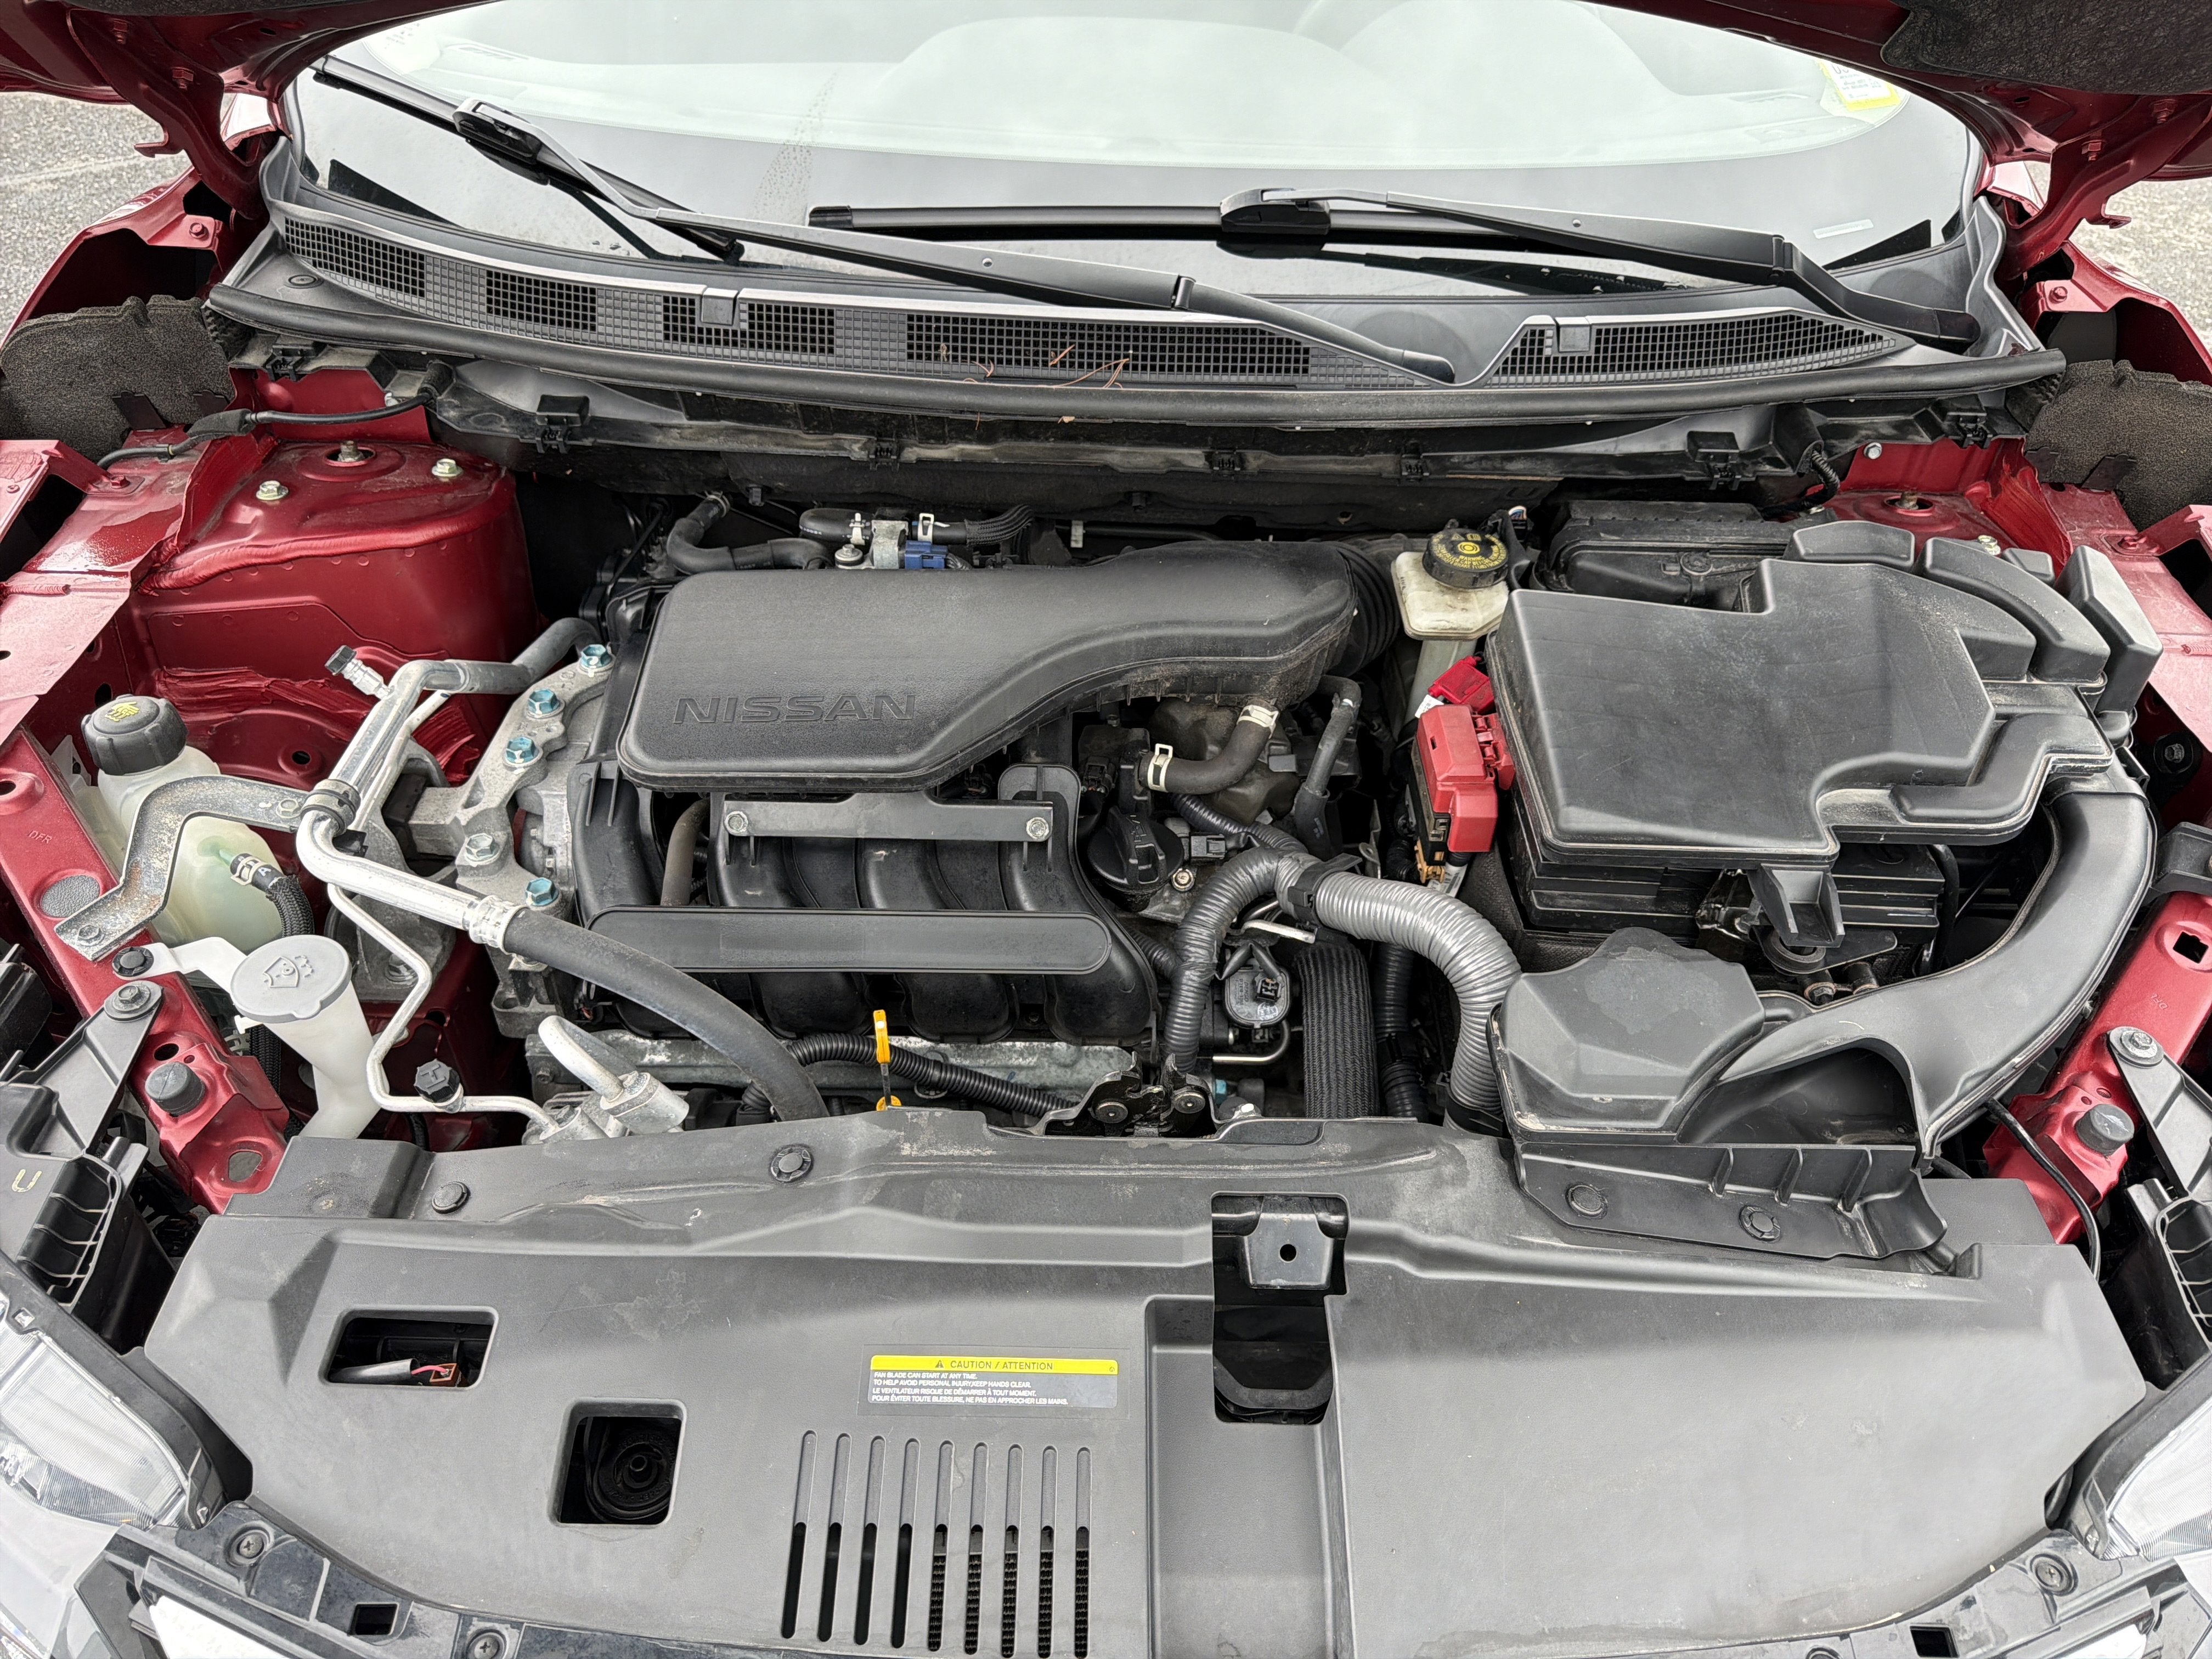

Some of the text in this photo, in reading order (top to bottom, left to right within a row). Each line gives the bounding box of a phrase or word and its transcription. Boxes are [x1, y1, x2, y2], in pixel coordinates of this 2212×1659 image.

[673, 695, 915, 724] NISSAN
[27, 830, 53, 844] DFR
[258, 867, 272, 877] A
[950, 1360, 992, 1369] CAUTION
[1002, 1361, 1053, 1370] ATTENTION
[890, 1394, 911, 1402] ÉVITER
